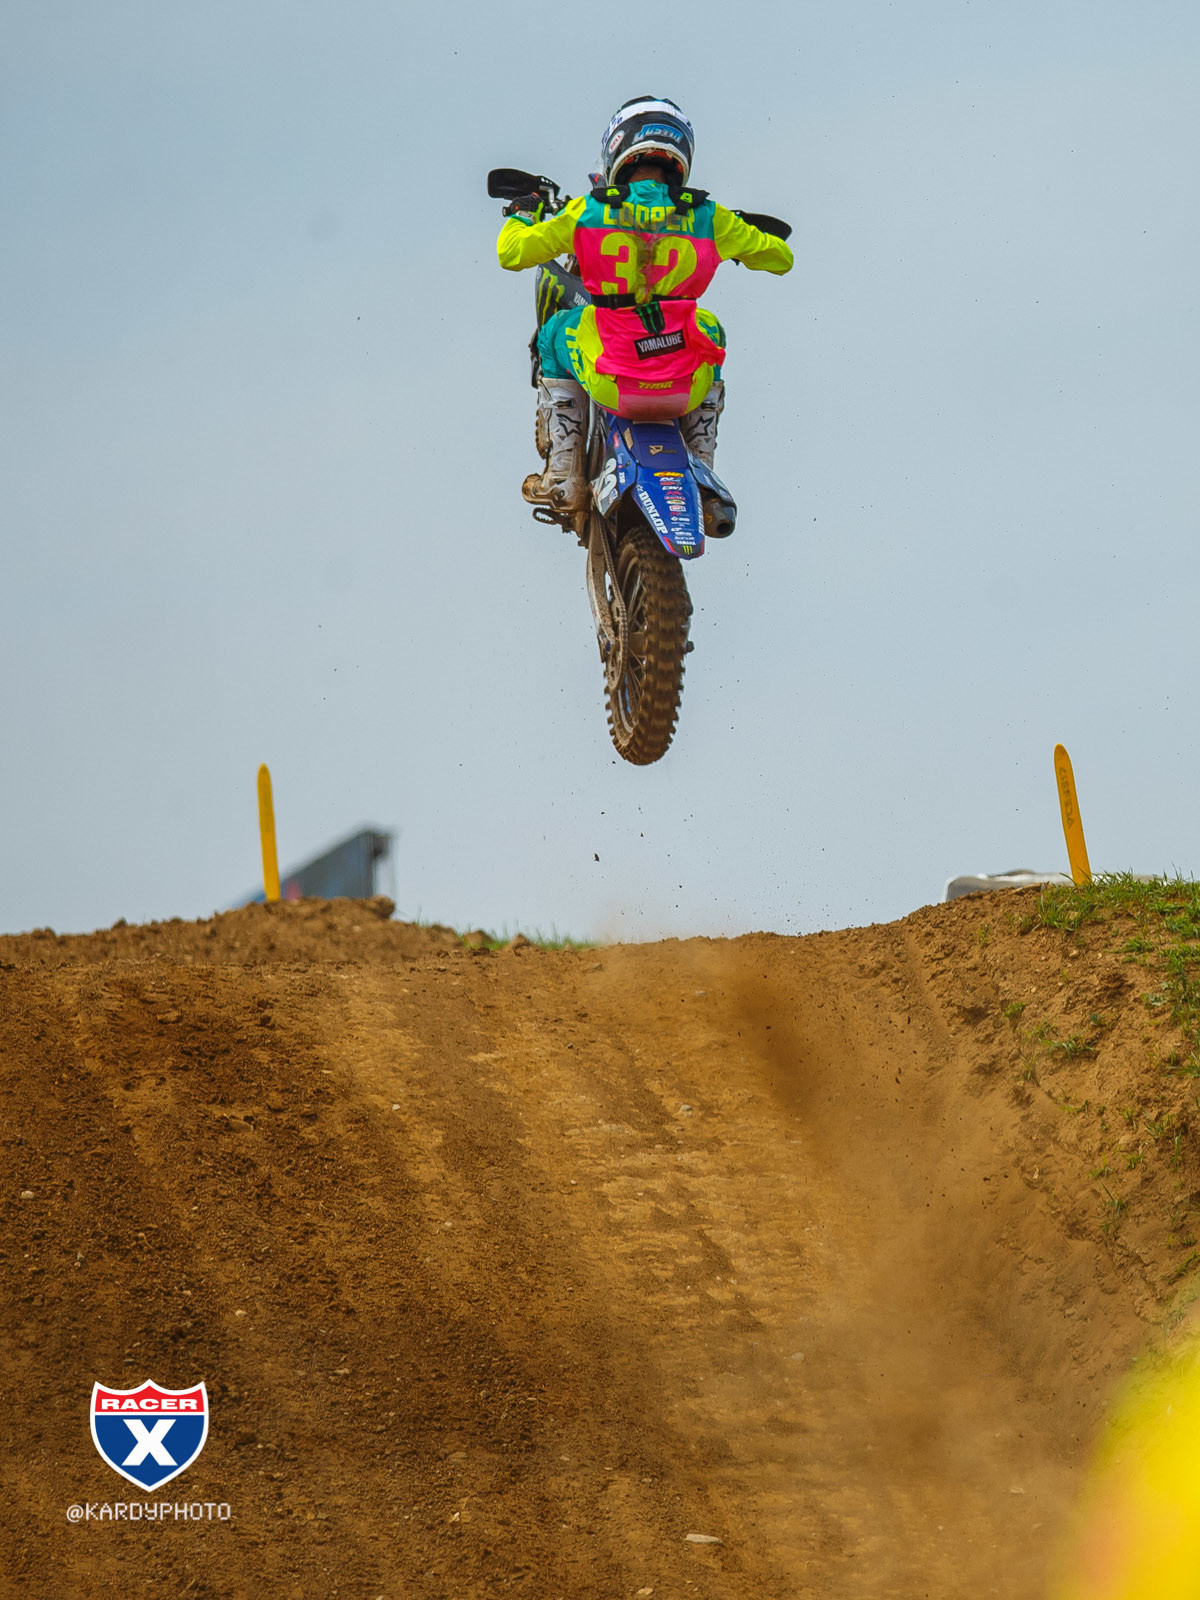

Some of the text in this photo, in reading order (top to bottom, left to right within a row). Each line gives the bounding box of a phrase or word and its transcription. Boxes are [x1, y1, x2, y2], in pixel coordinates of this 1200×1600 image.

[609, 134, 622, 151] BELL
[603, 202, 696, 233] COOPER
[600, 231, 698, 297] 32
[637, 333, 684, 354] YAMALUBE
[639, 381, 674, 390] THOR
[638, 490, 669, 534] DUNLOP
